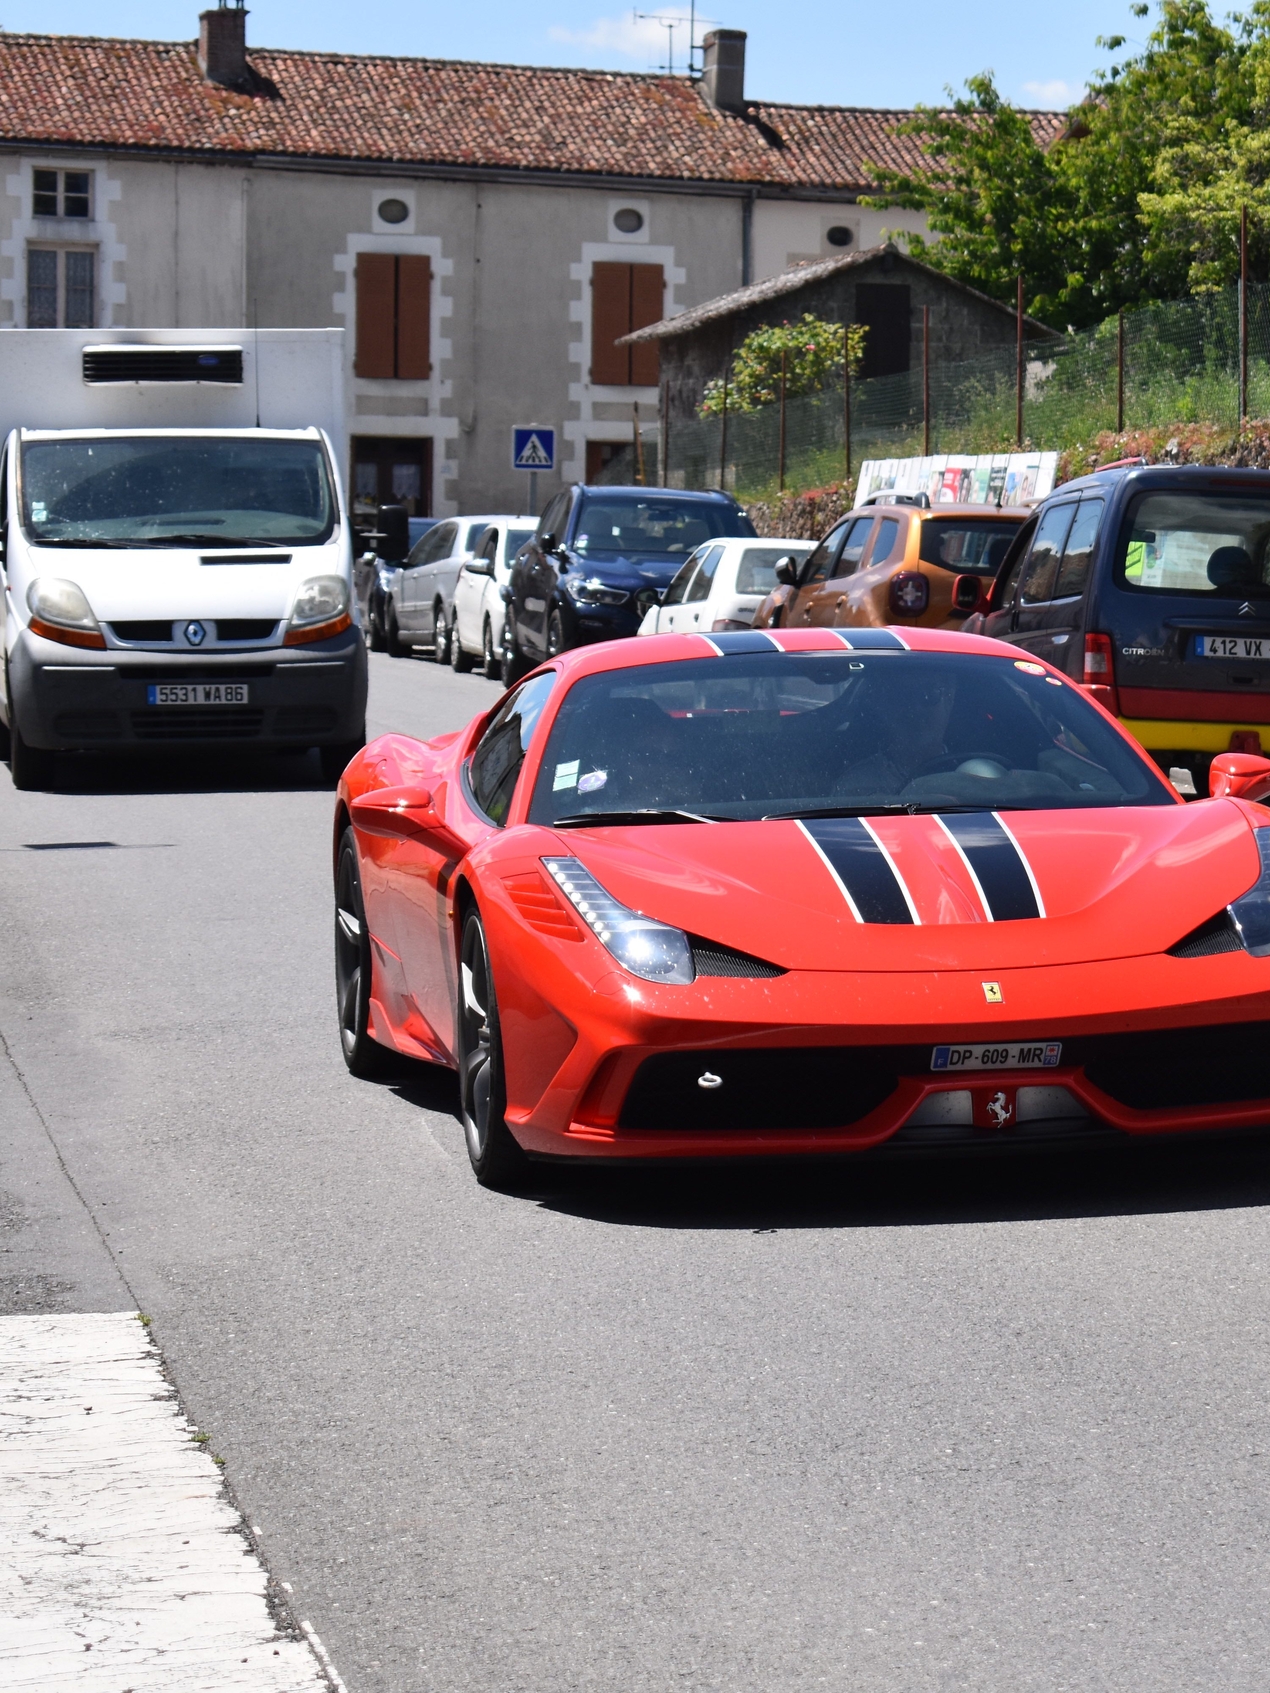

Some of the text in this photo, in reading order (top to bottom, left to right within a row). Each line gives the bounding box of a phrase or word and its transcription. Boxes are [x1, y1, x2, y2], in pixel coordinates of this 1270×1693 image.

[1209, 638, 1238, 656] 412
[1243, 640, 1262, 657] VX
[160, 686, 244, 703] 5531 WA 86
[1045, 1056, 1057, 1064] 78
